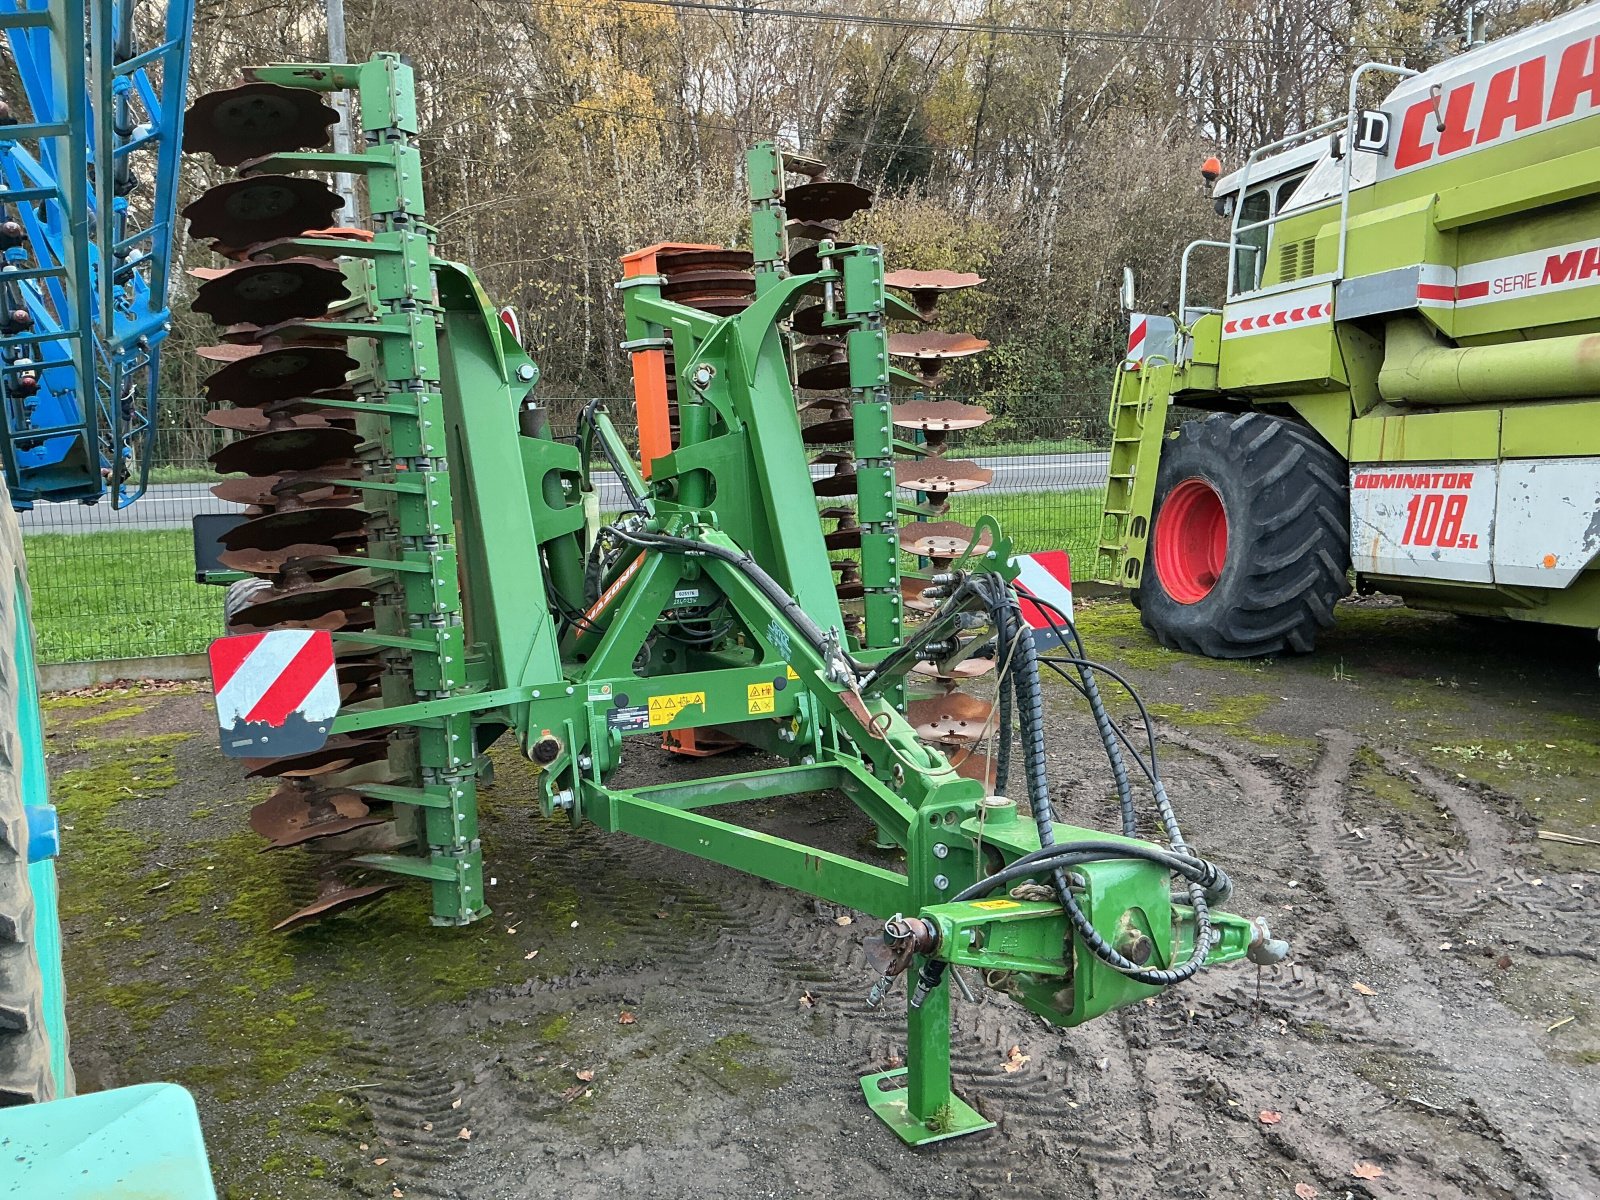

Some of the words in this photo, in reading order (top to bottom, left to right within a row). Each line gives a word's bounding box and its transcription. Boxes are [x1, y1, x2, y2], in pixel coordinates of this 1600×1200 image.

[1363, 111, 1389, 151] D
[1493, 271, 1538, 294] SERIE
[1354, 473, 1474, 489] DOMINATOR
